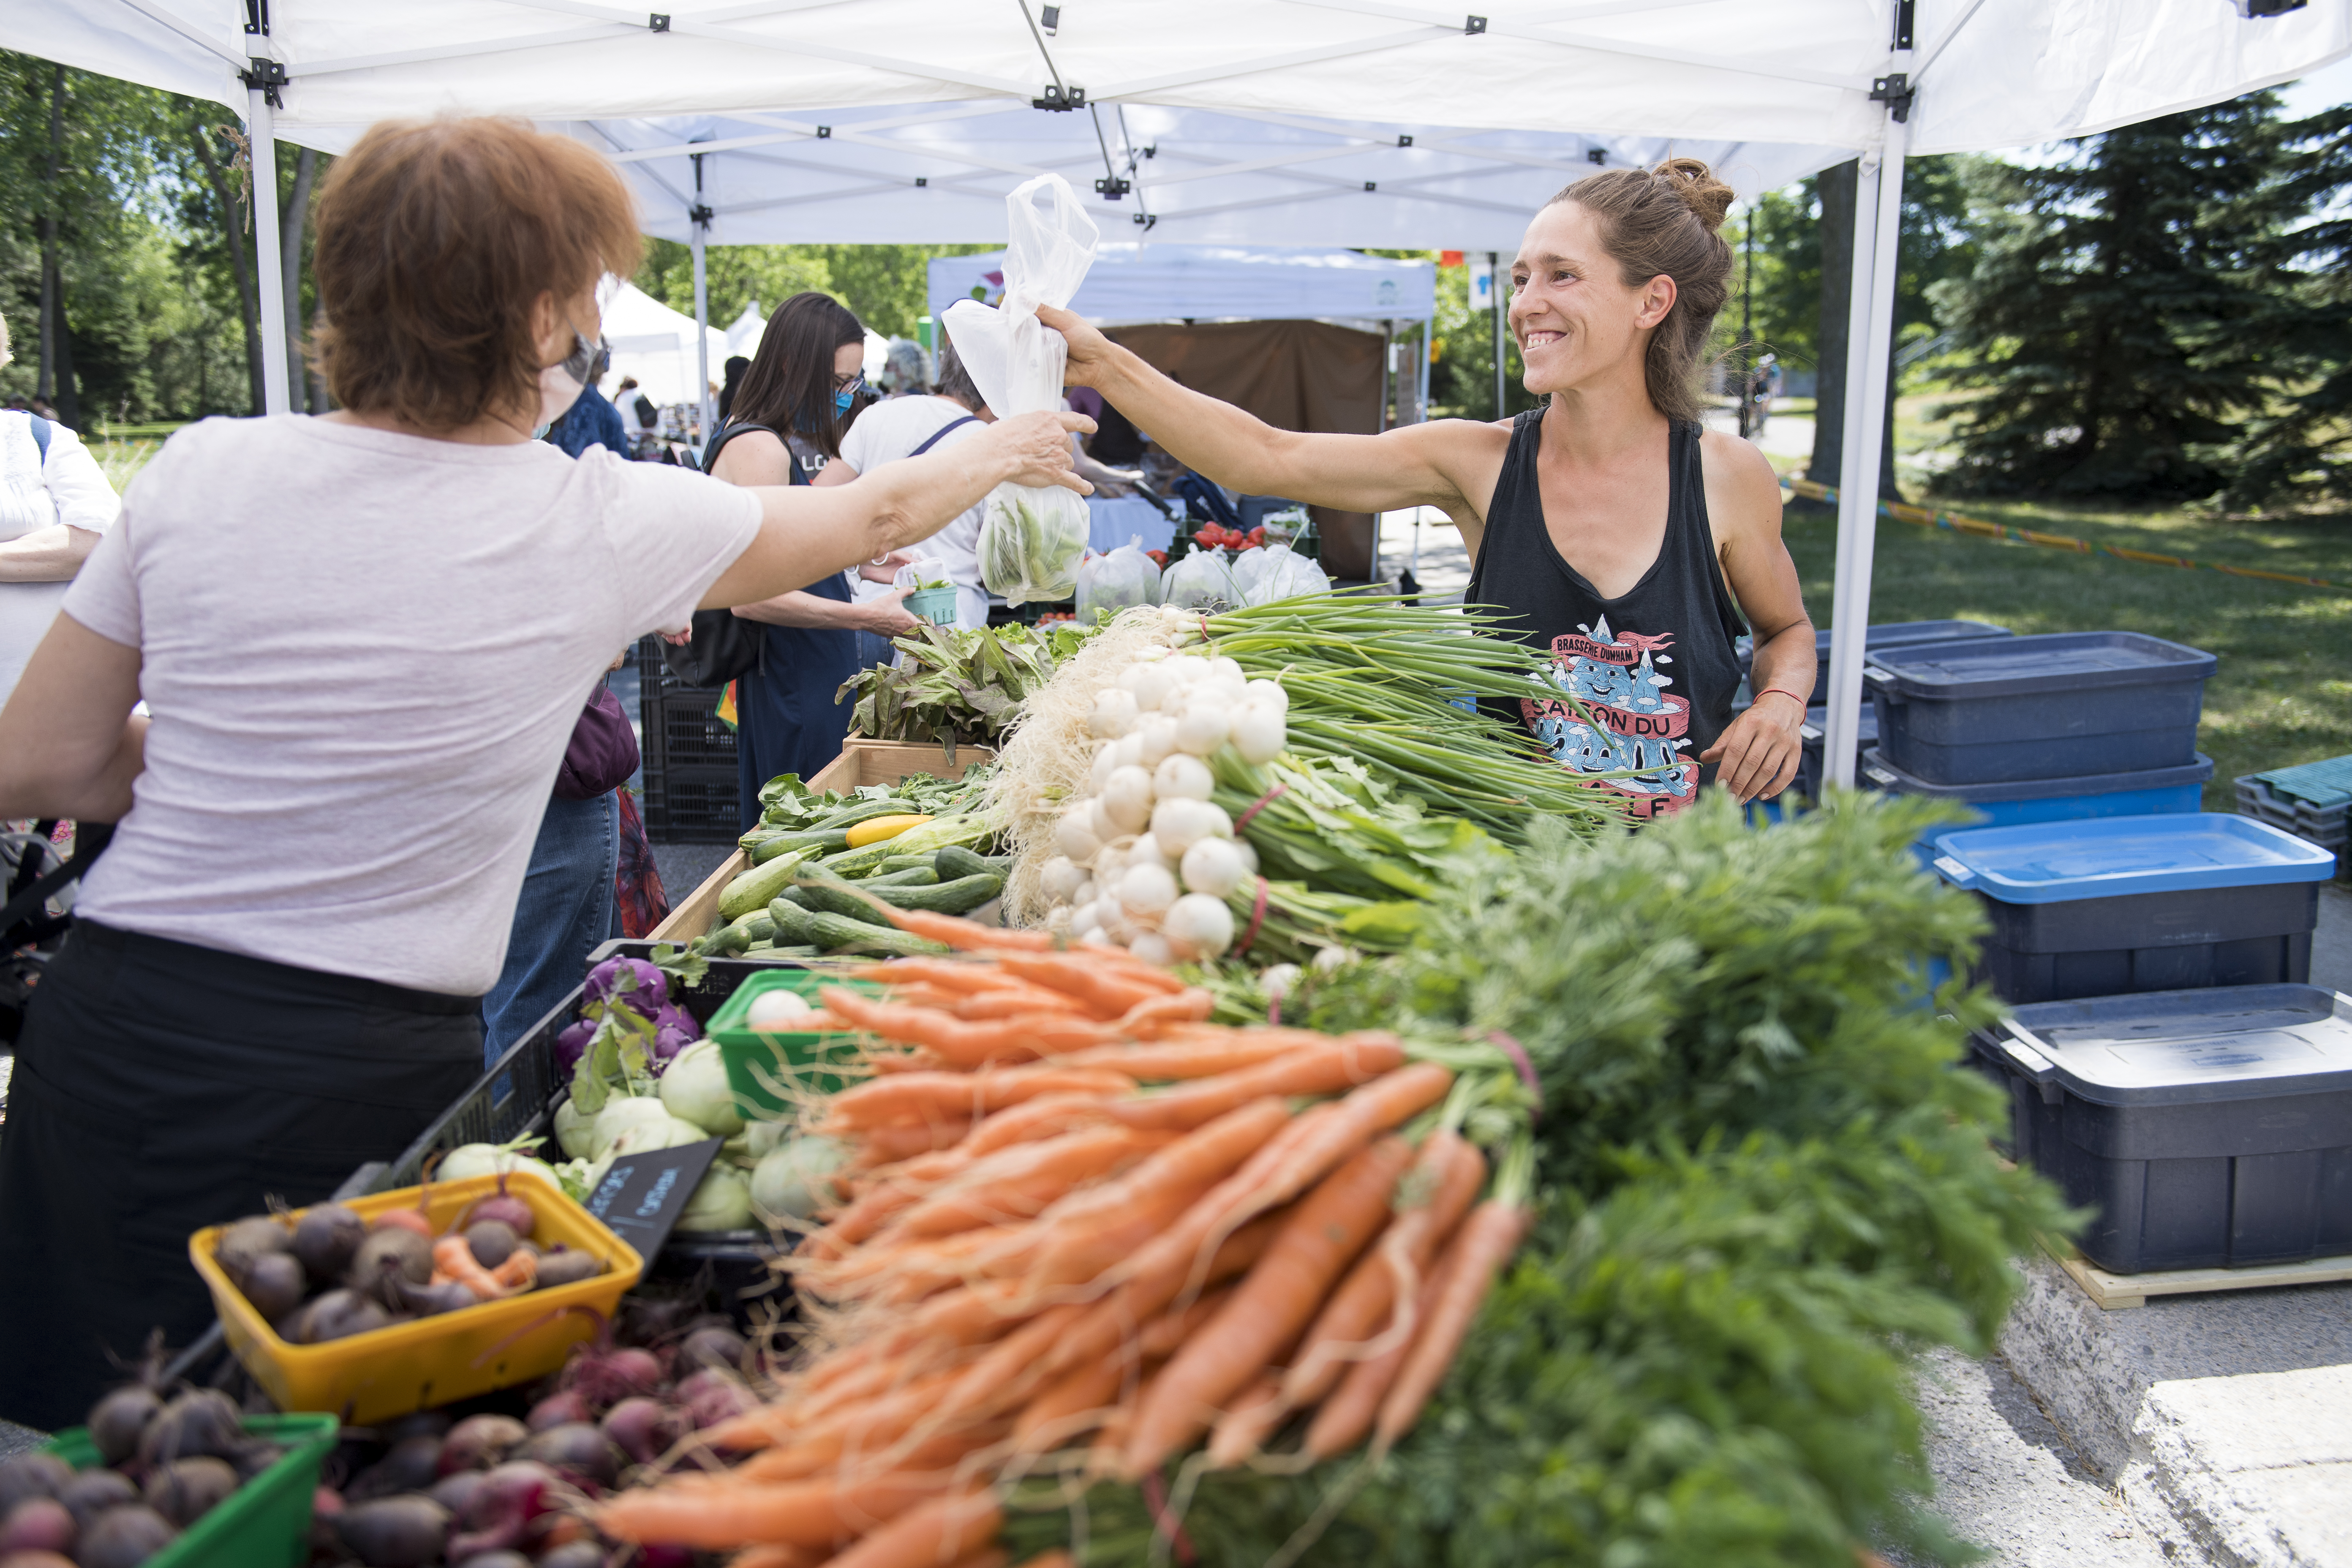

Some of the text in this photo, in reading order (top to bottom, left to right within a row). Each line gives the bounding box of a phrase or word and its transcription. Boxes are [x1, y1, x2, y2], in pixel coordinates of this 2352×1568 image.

[1557, 638, 1633, 662] BRASSERIE DUNHAM
[1531, 699, 1670, 736] SAISON DU
